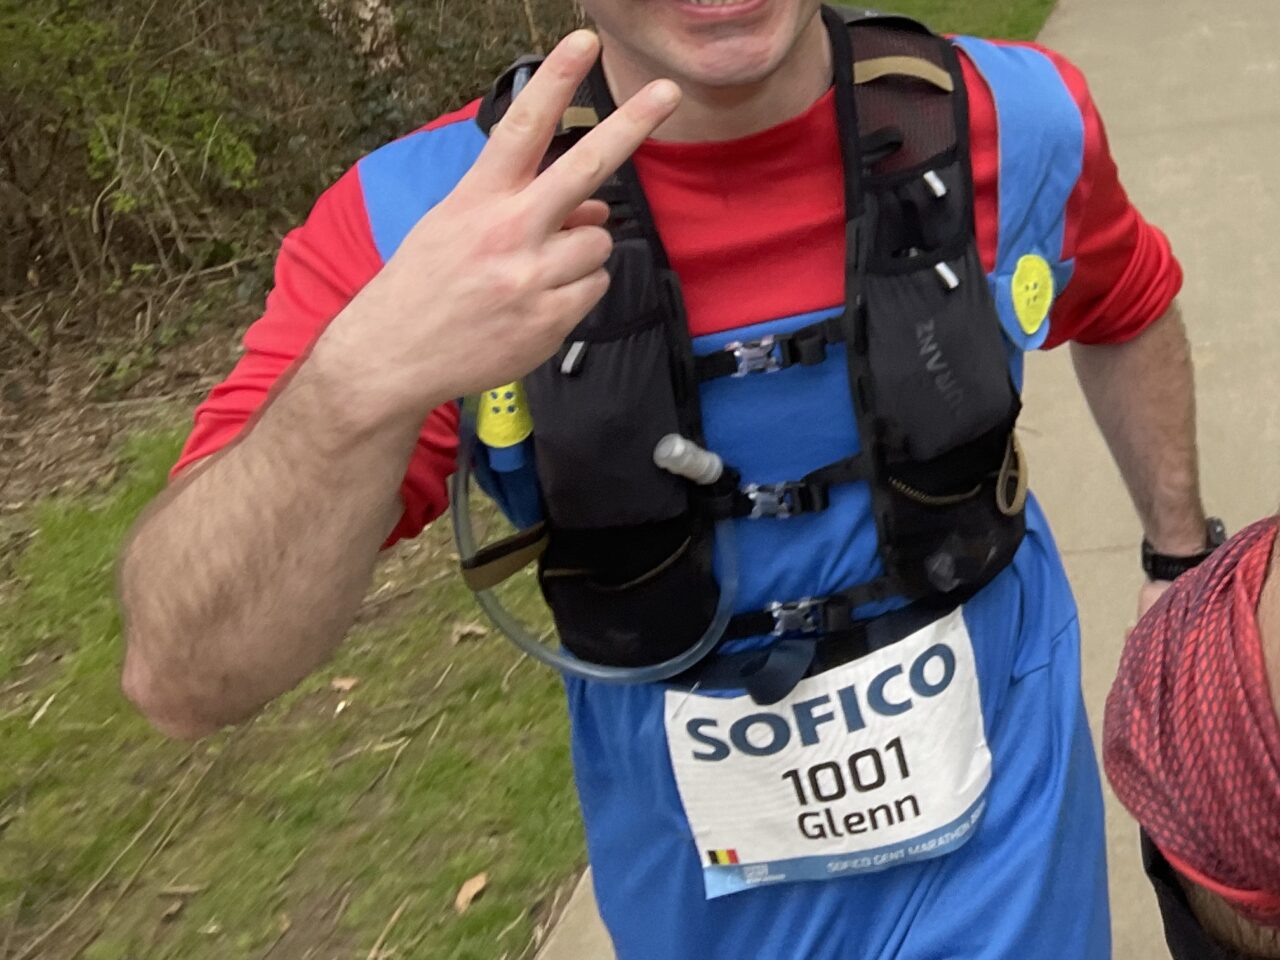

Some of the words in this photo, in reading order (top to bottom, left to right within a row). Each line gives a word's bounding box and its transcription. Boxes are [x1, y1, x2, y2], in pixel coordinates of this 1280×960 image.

[915, 317, 970, 423] URANZ
[685, 642, 957, 763] SOFICO
[781, 736, 911, 807] 1001
[797, 793, 922, 841] Glenn
[873, 847, 906, 866] GENT
[907, 821, 971, 856] MARATHON
